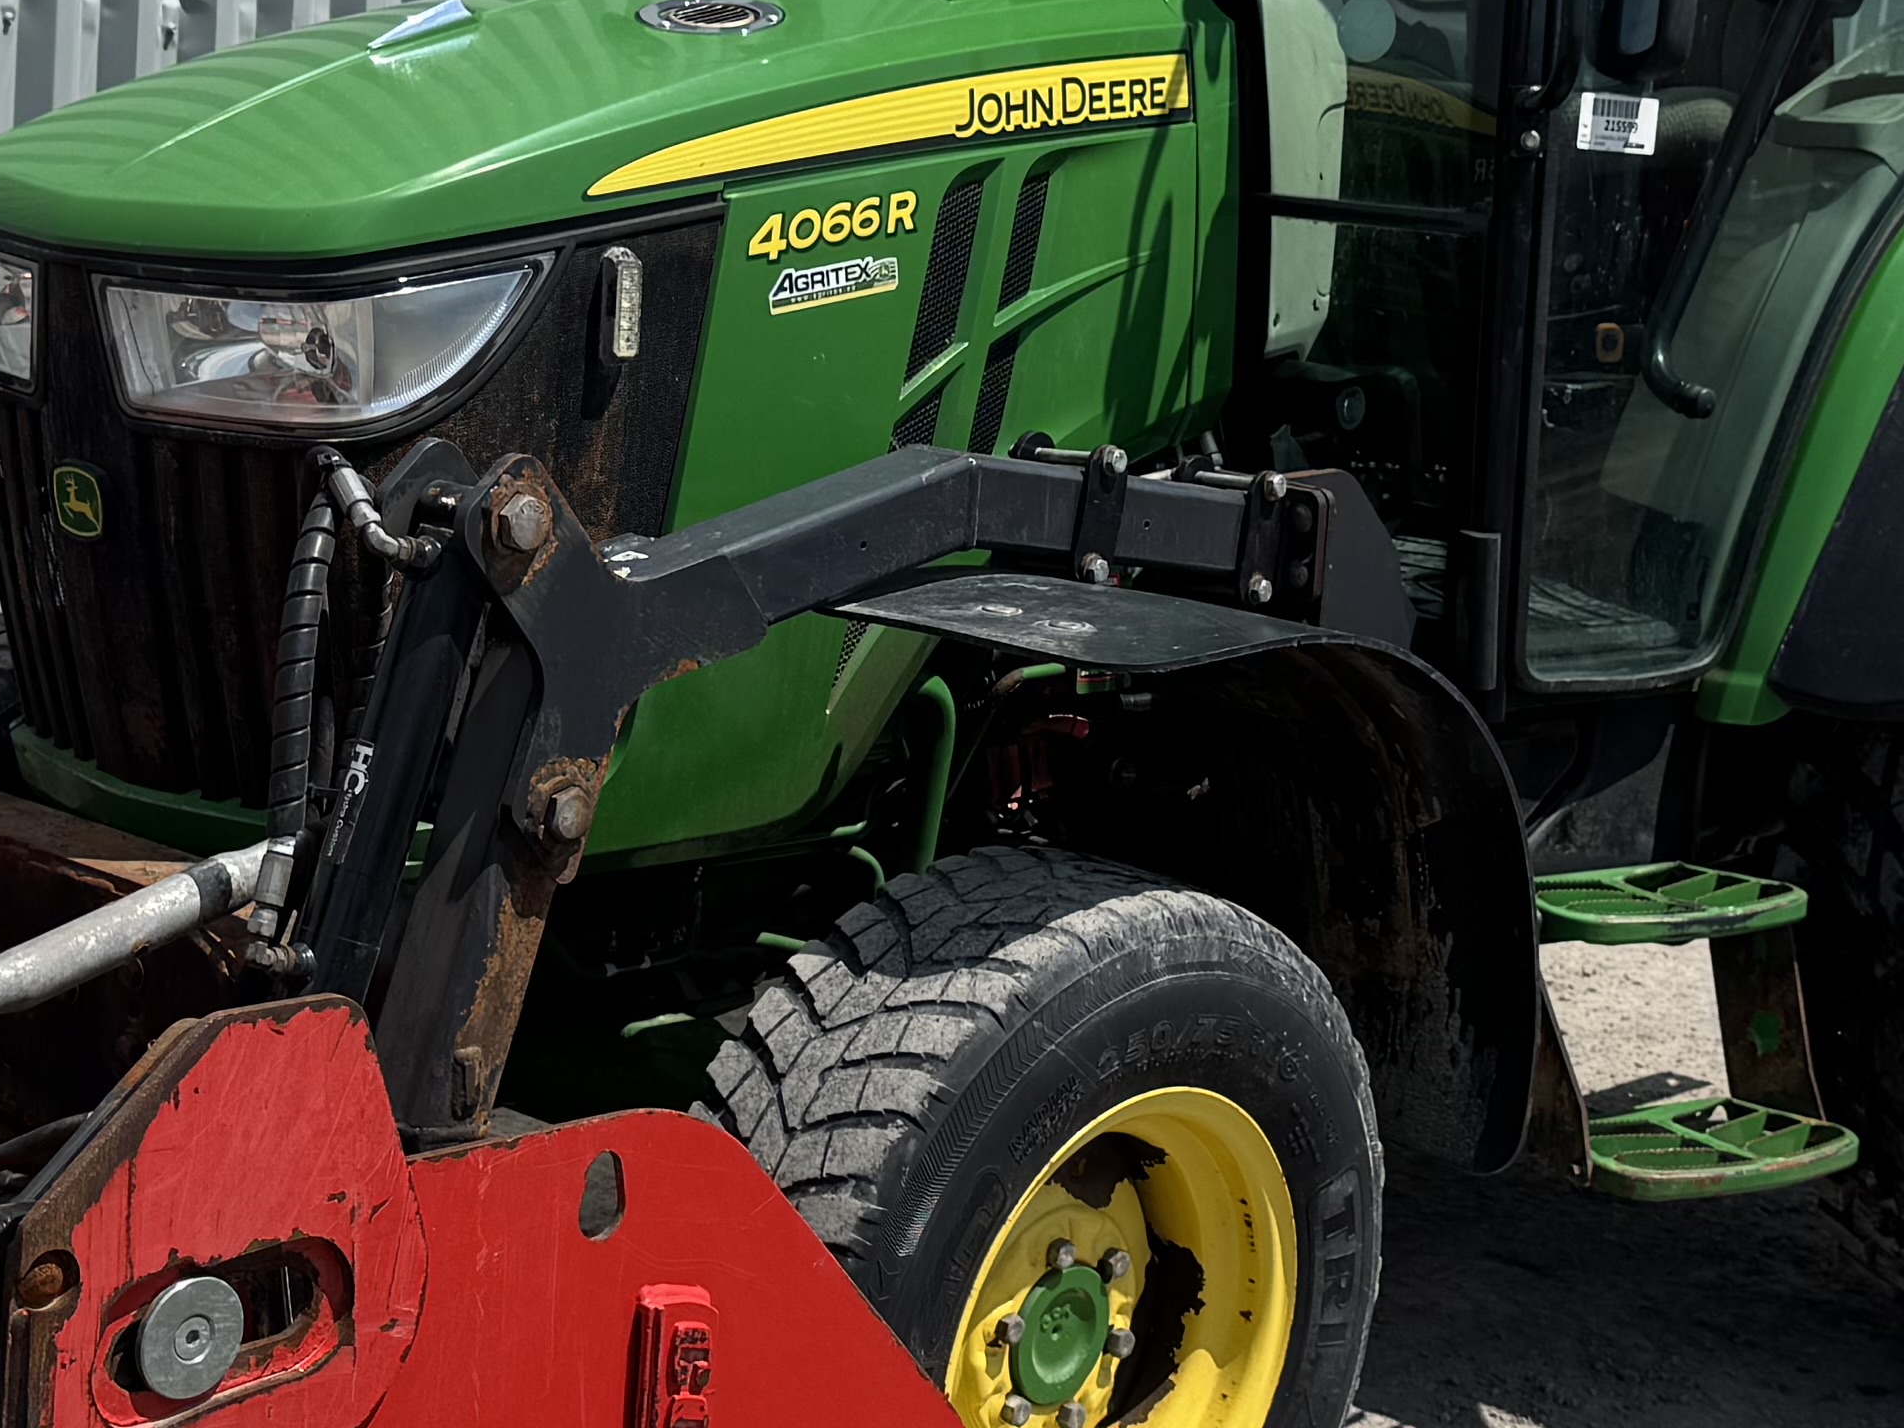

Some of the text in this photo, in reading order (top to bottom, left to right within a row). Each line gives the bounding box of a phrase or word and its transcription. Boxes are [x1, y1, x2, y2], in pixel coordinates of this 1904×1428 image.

[955, 76, 1168, 134] JOHN DEERE
[749, 190, 918, 260] 4066R
[773, 261, 871, 298] AGRITEX
[343, 744, 374, 795] HC
[1315, 1192, 1361, 1348] TRI
